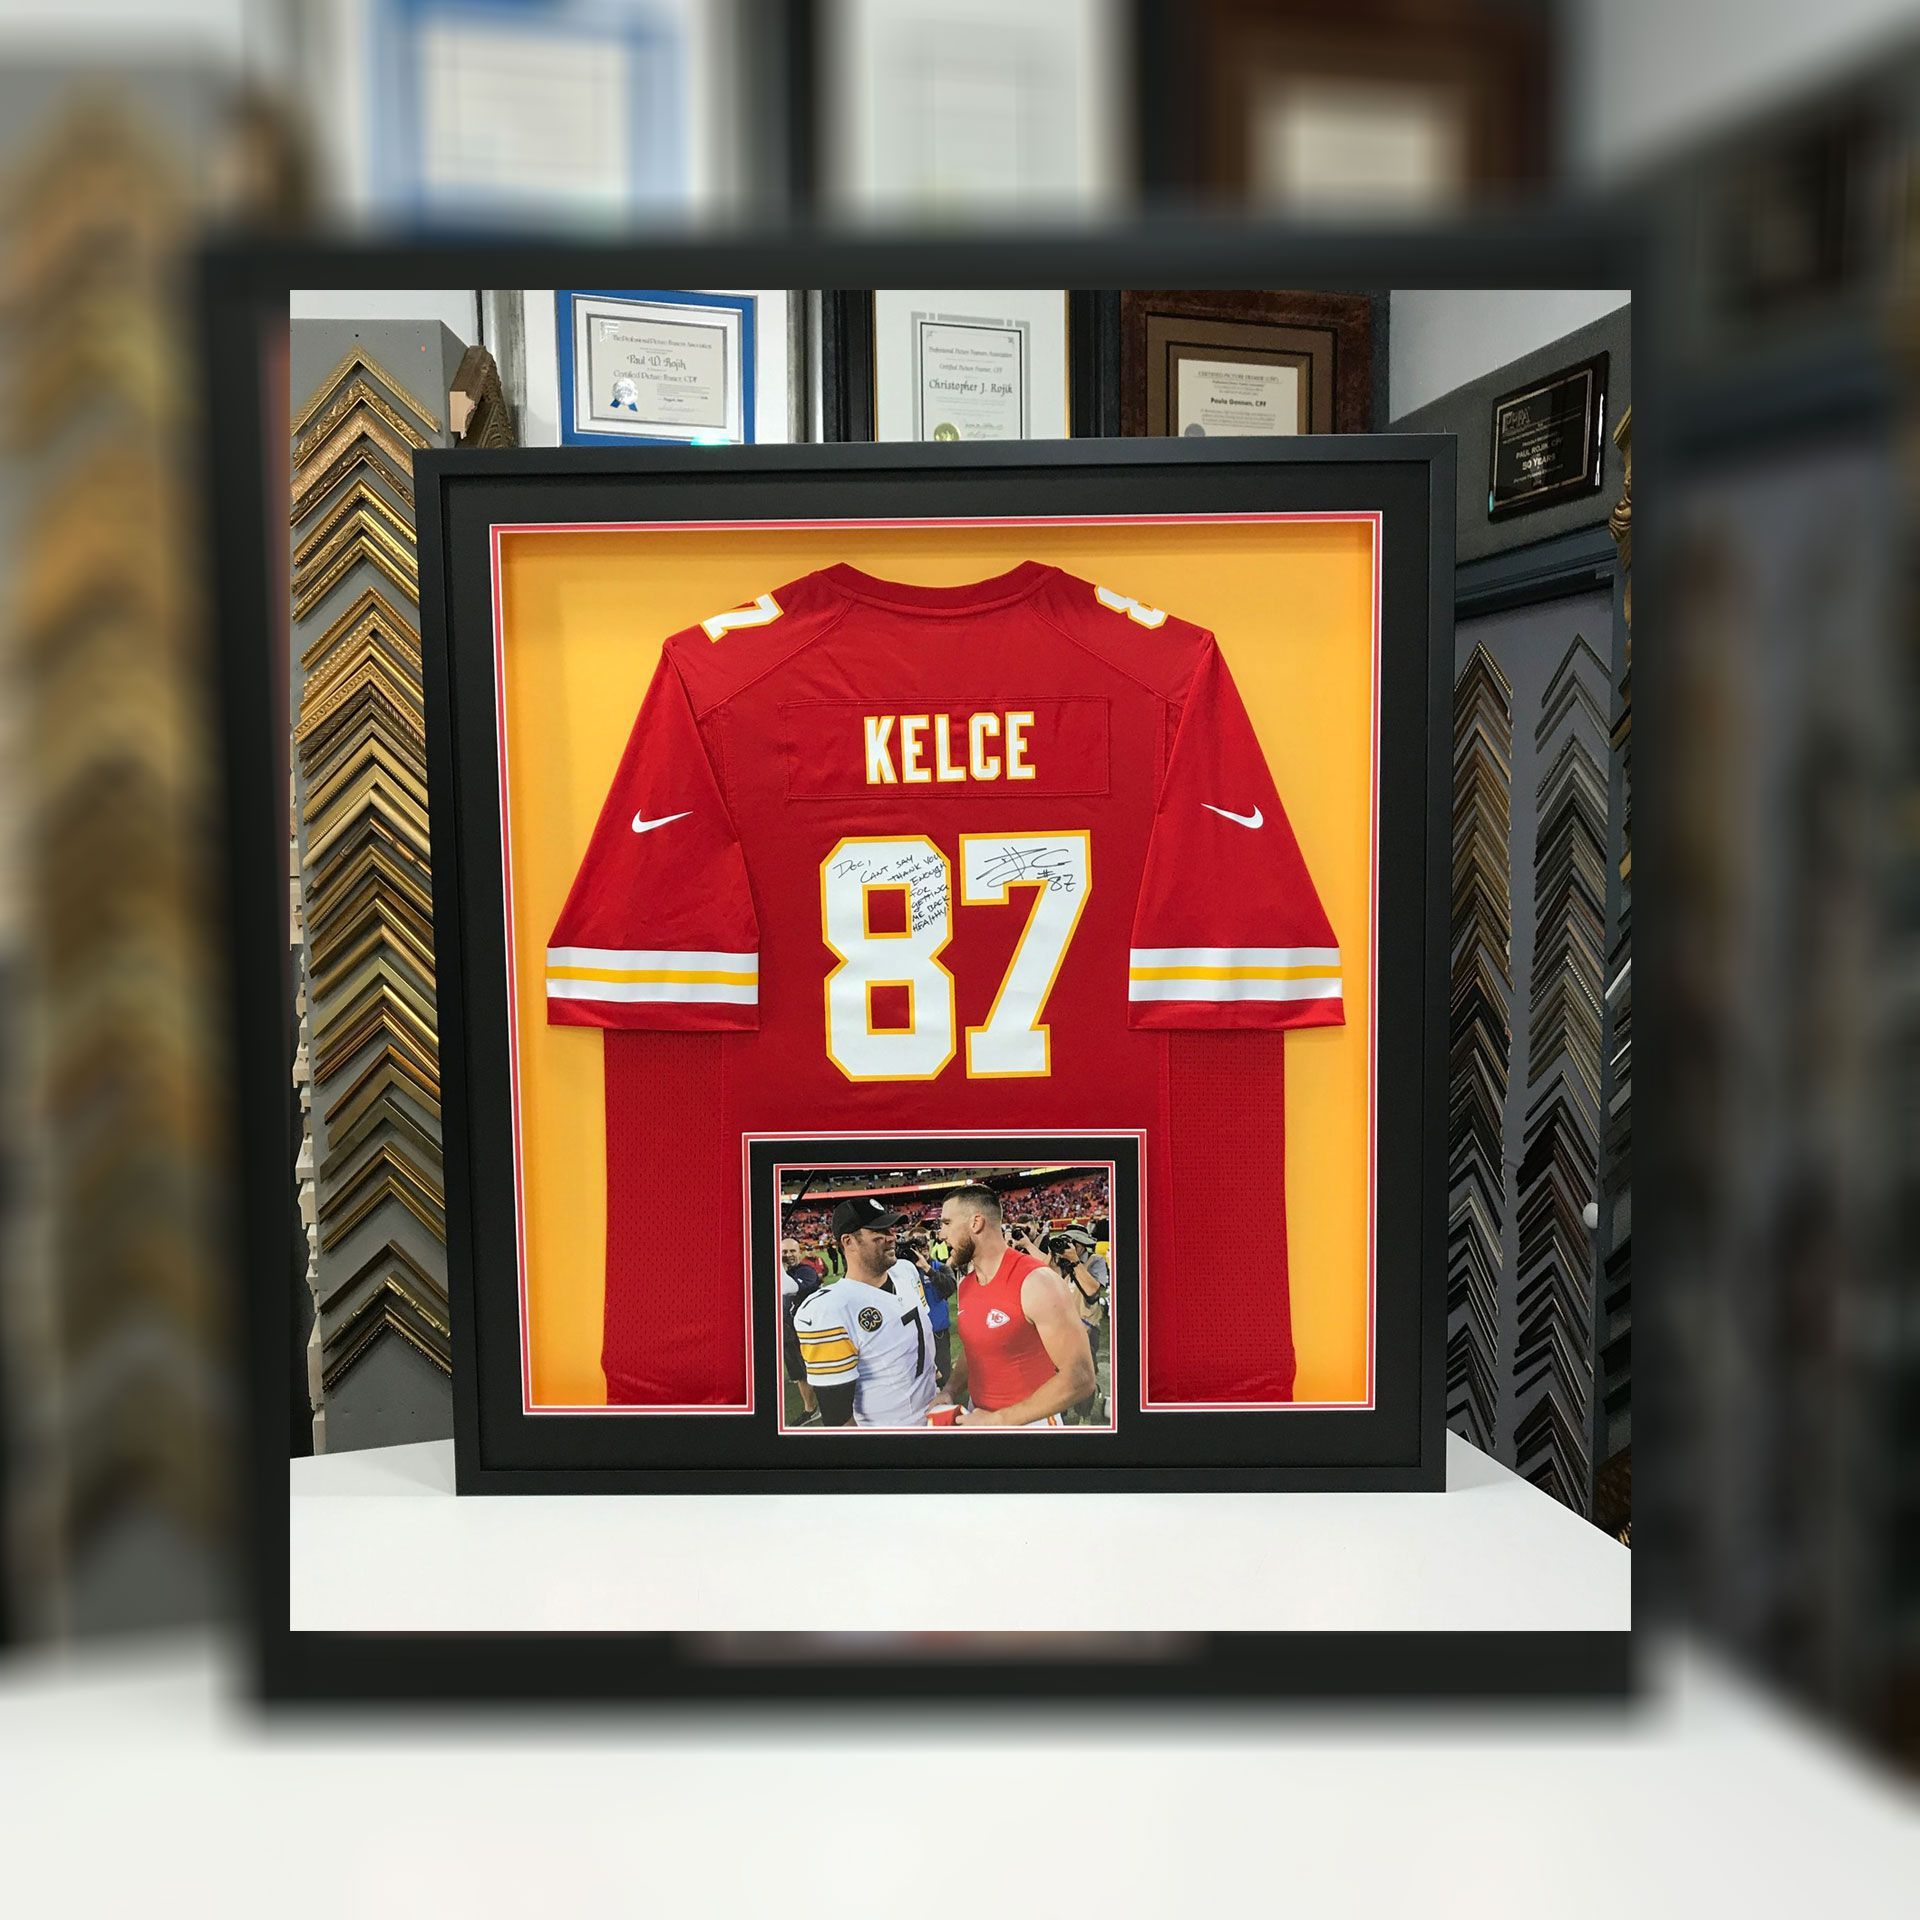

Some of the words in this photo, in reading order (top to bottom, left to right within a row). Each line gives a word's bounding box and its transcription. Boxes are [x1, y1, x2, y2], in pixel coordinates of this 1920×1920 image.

[929, 379, 977, 394] Christopher
[991, 384, 1013, 397] Rojik
[863, 711, 1036, 784] KELCE
[820, 829, 1092, 1082] 87
